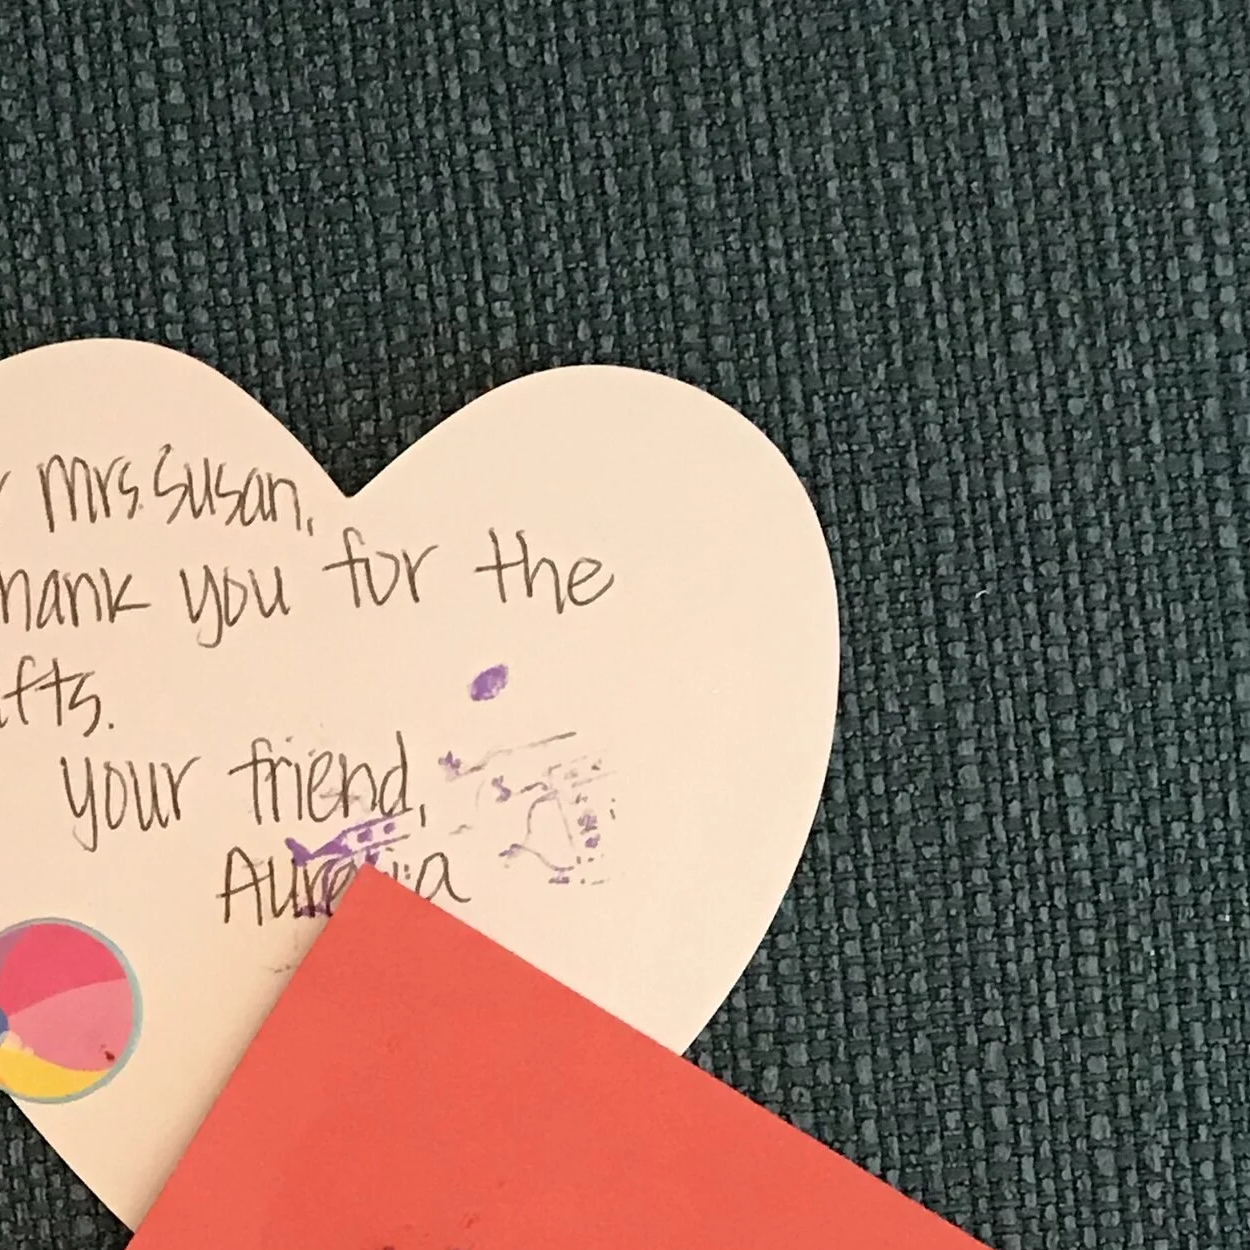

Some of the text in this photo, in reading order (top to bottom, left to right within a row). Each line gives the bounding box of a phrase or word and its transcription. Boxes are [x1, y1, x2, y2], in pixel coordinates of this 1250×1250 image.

[153, 443, 315, 537] Susan,
[179, 564, 291, 648] you
[321, 526, 440, 609] for
[473, 527, 616, 615] the
[227, 730, 427, 829] friend,
